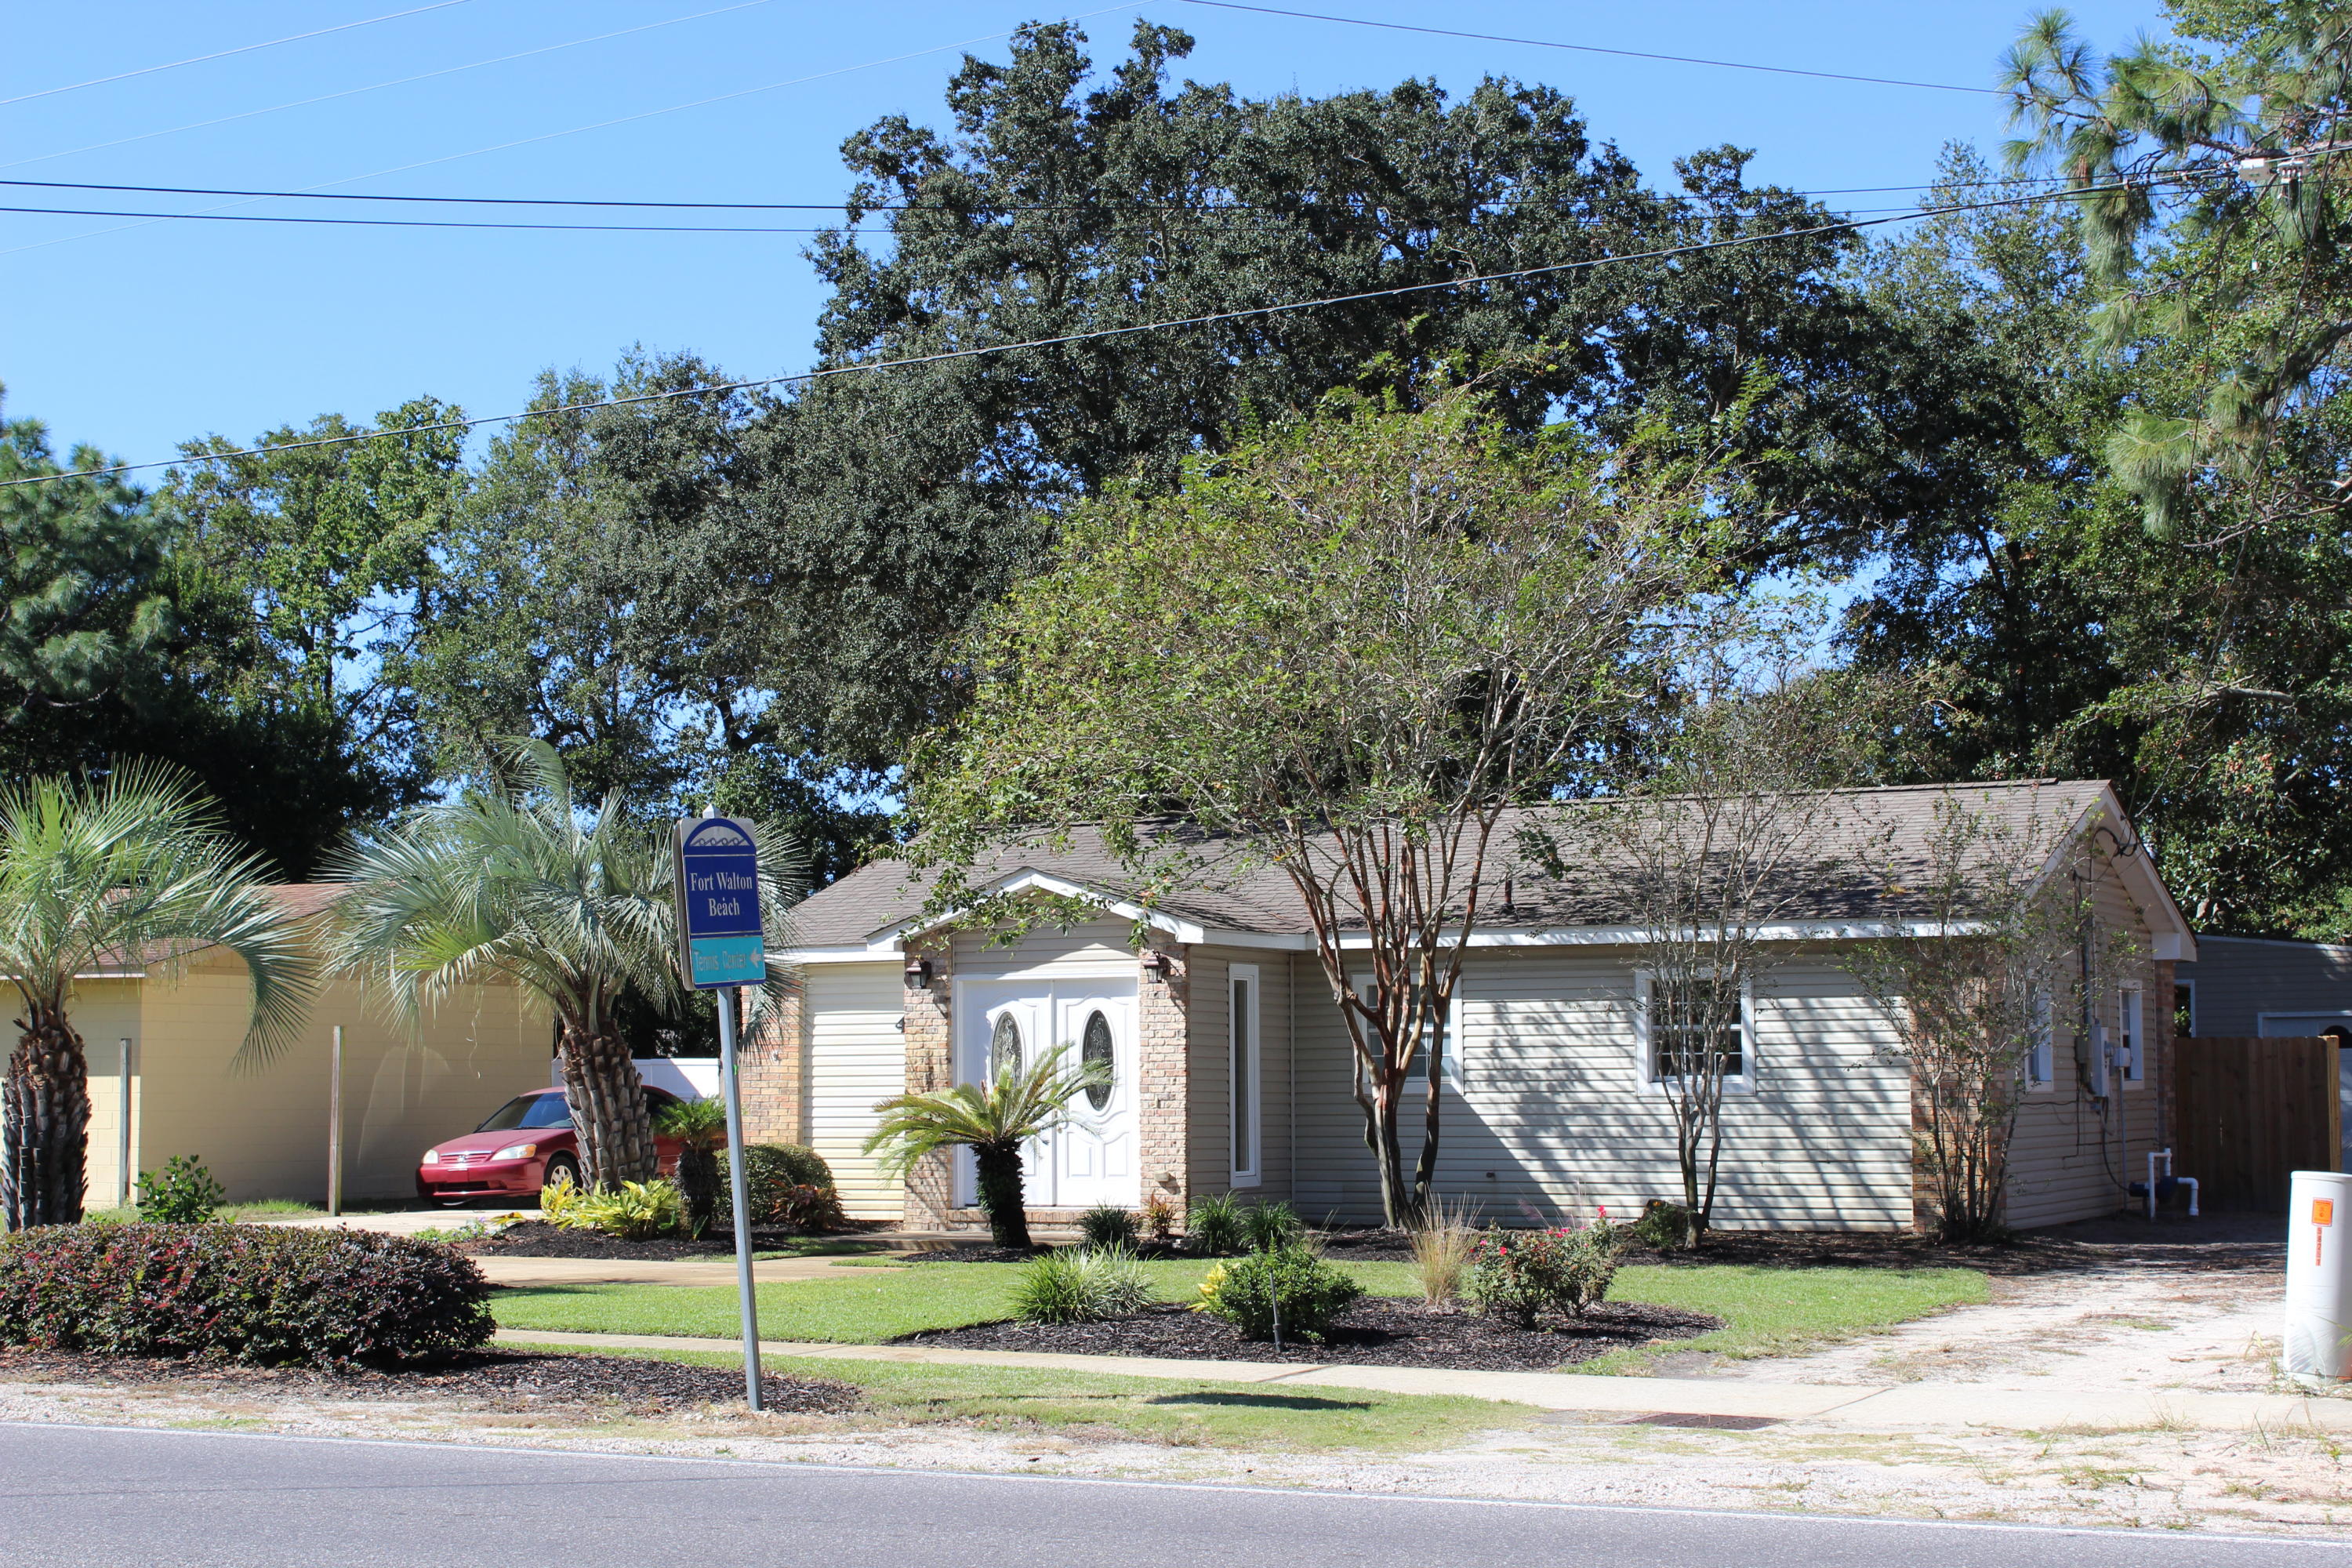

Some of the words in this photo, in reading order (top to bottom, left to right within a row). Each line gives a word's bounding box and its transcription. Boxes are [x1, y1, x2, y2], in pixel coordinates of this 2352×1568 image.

[690, 872, 714, 891] Fort
[716, 871, 753, 891] Walton
[709, 898, 740, 916] Beach
